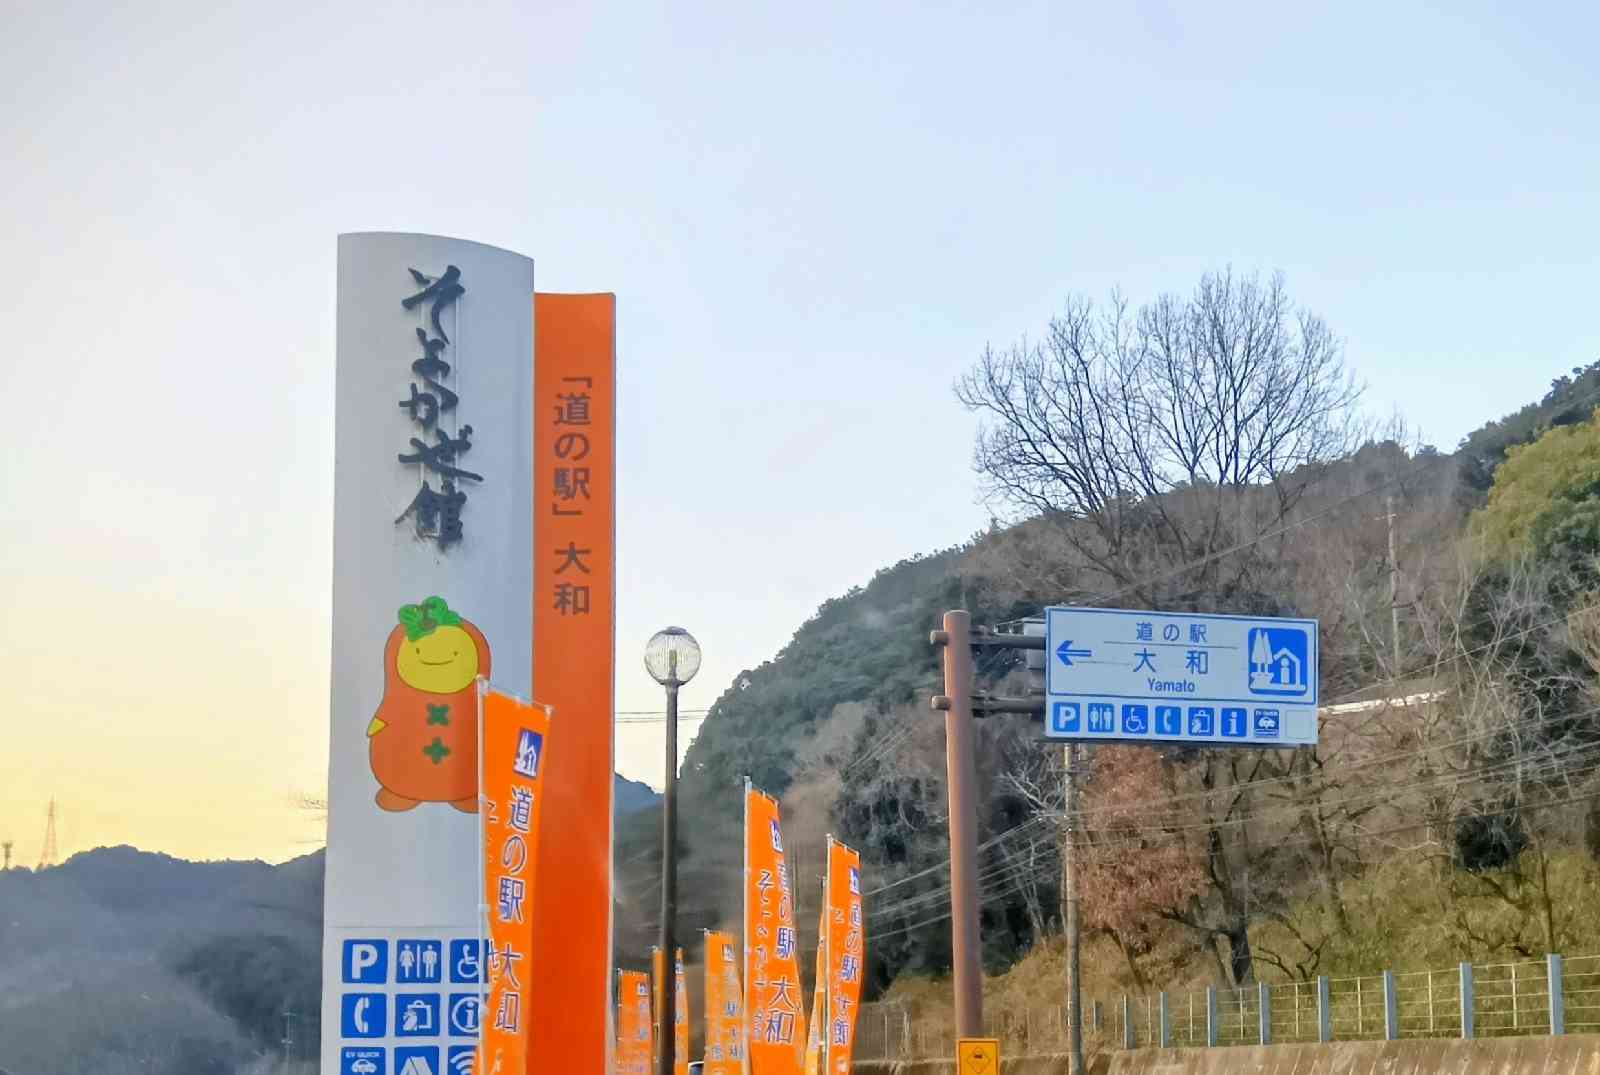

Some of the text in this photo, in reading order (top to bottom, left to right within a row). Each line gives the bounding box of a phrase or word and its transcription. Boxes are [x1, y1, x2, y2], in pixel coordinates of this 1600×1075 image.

[553, 541, 592, 615] 大和
[1136, 622, 1207, 643] 道の駅
[1133, 648, 1208, 675] 大和
[1147, 678, 1195, 693] Yamato
[497, 785, 535, 924] 道の駅
[352, 944, 378, 980] P
[767, 975, 797, 1043] 大和
